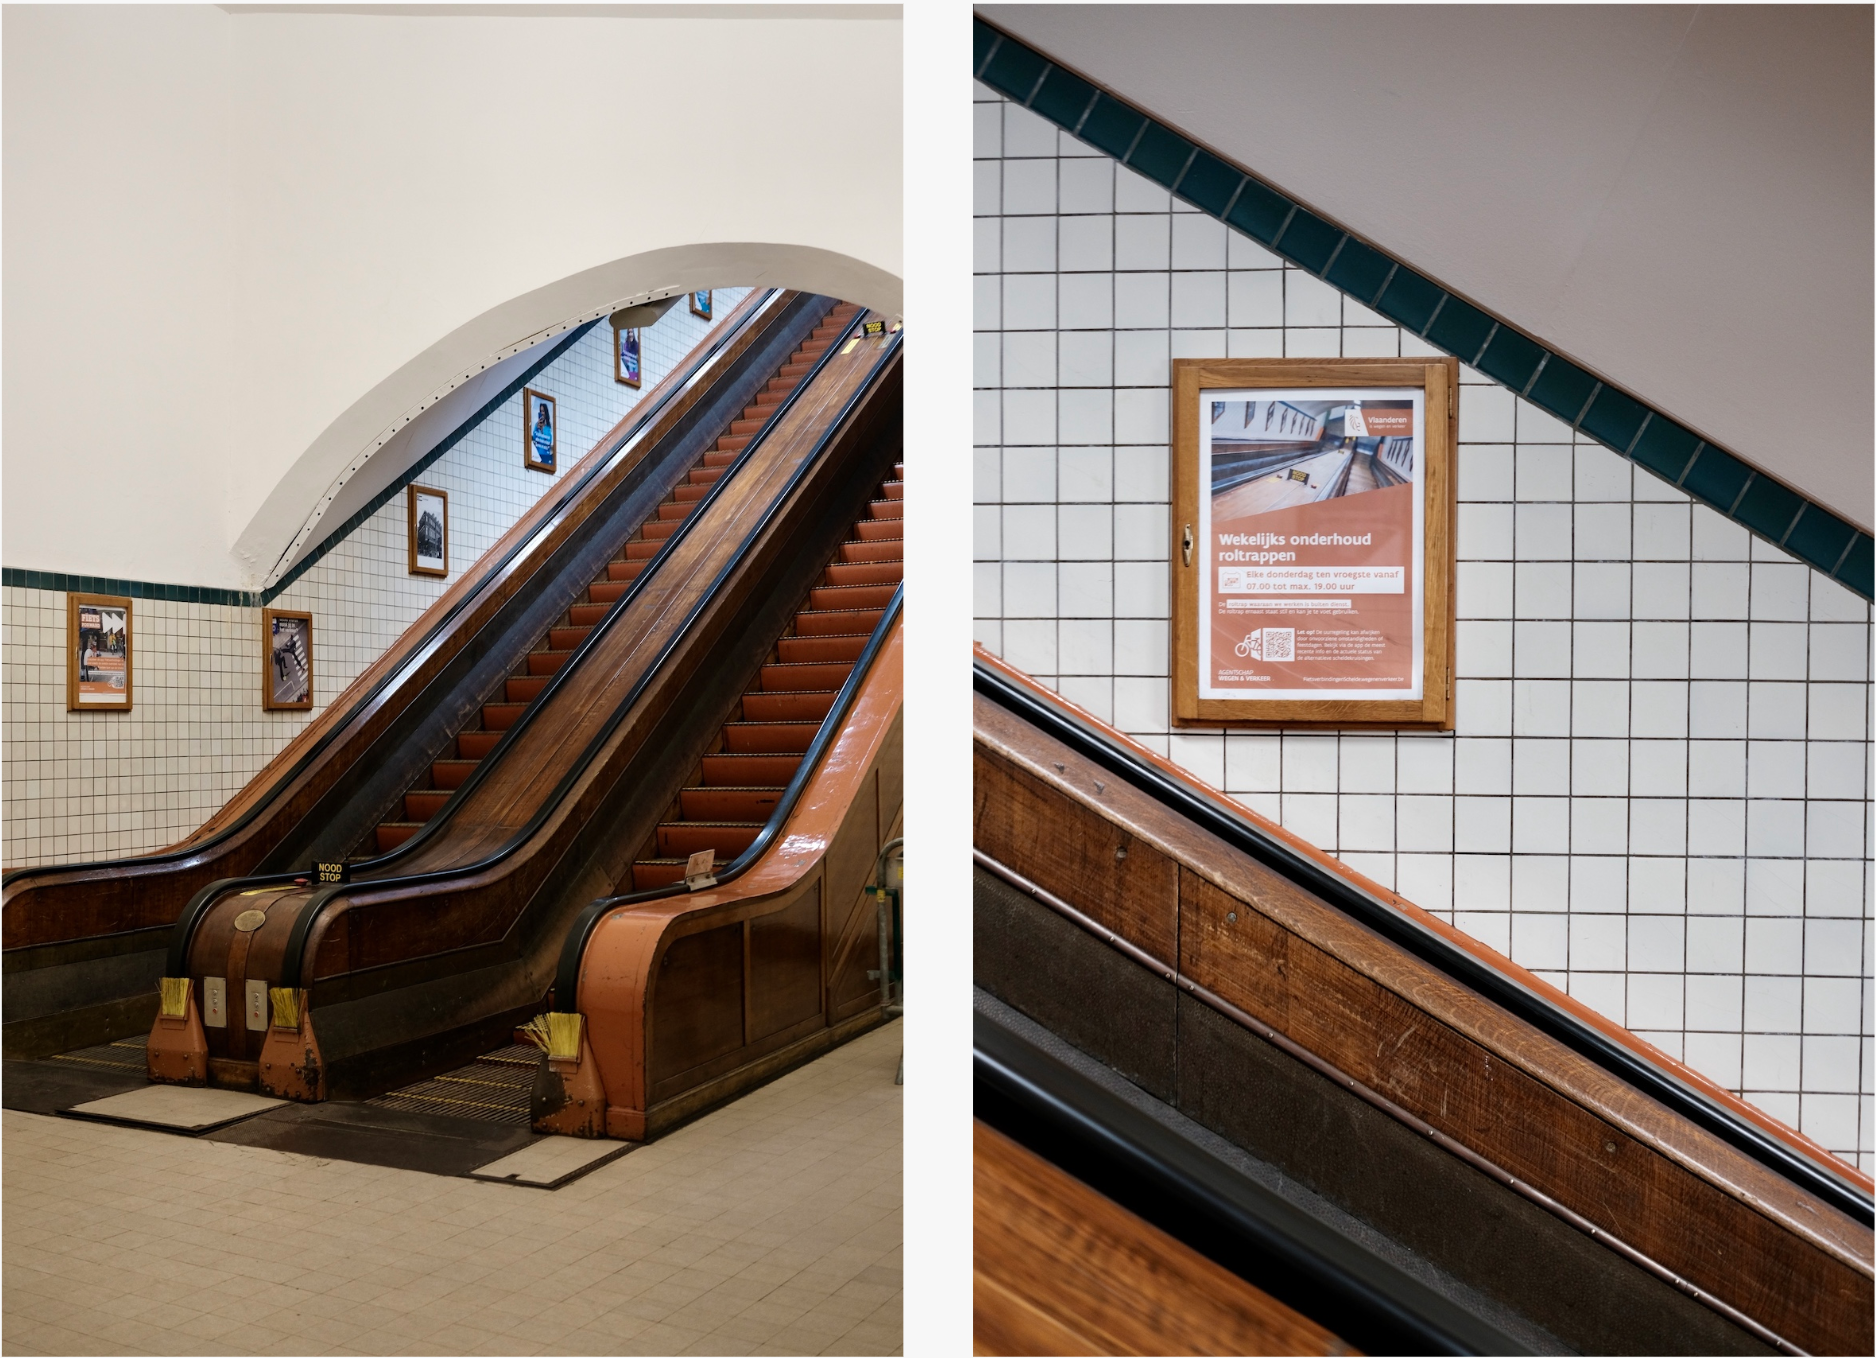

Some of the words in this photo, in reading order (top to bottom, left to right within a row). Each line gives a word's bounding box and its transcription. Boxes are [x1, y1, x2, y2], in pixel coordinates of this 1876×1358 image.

[1218, 533, 1286, 548] Wekelijks
[1290, 533, 1371, 546] onderhoud
[1219, 549, 1296, 564] roltrappen
[1267, 571, 1313, 580] donderdag
[1334, 572, 1371, 580] vroegste
[319, 863, 342, 872] NOOD
[320, 872, 340, 882] STOP
